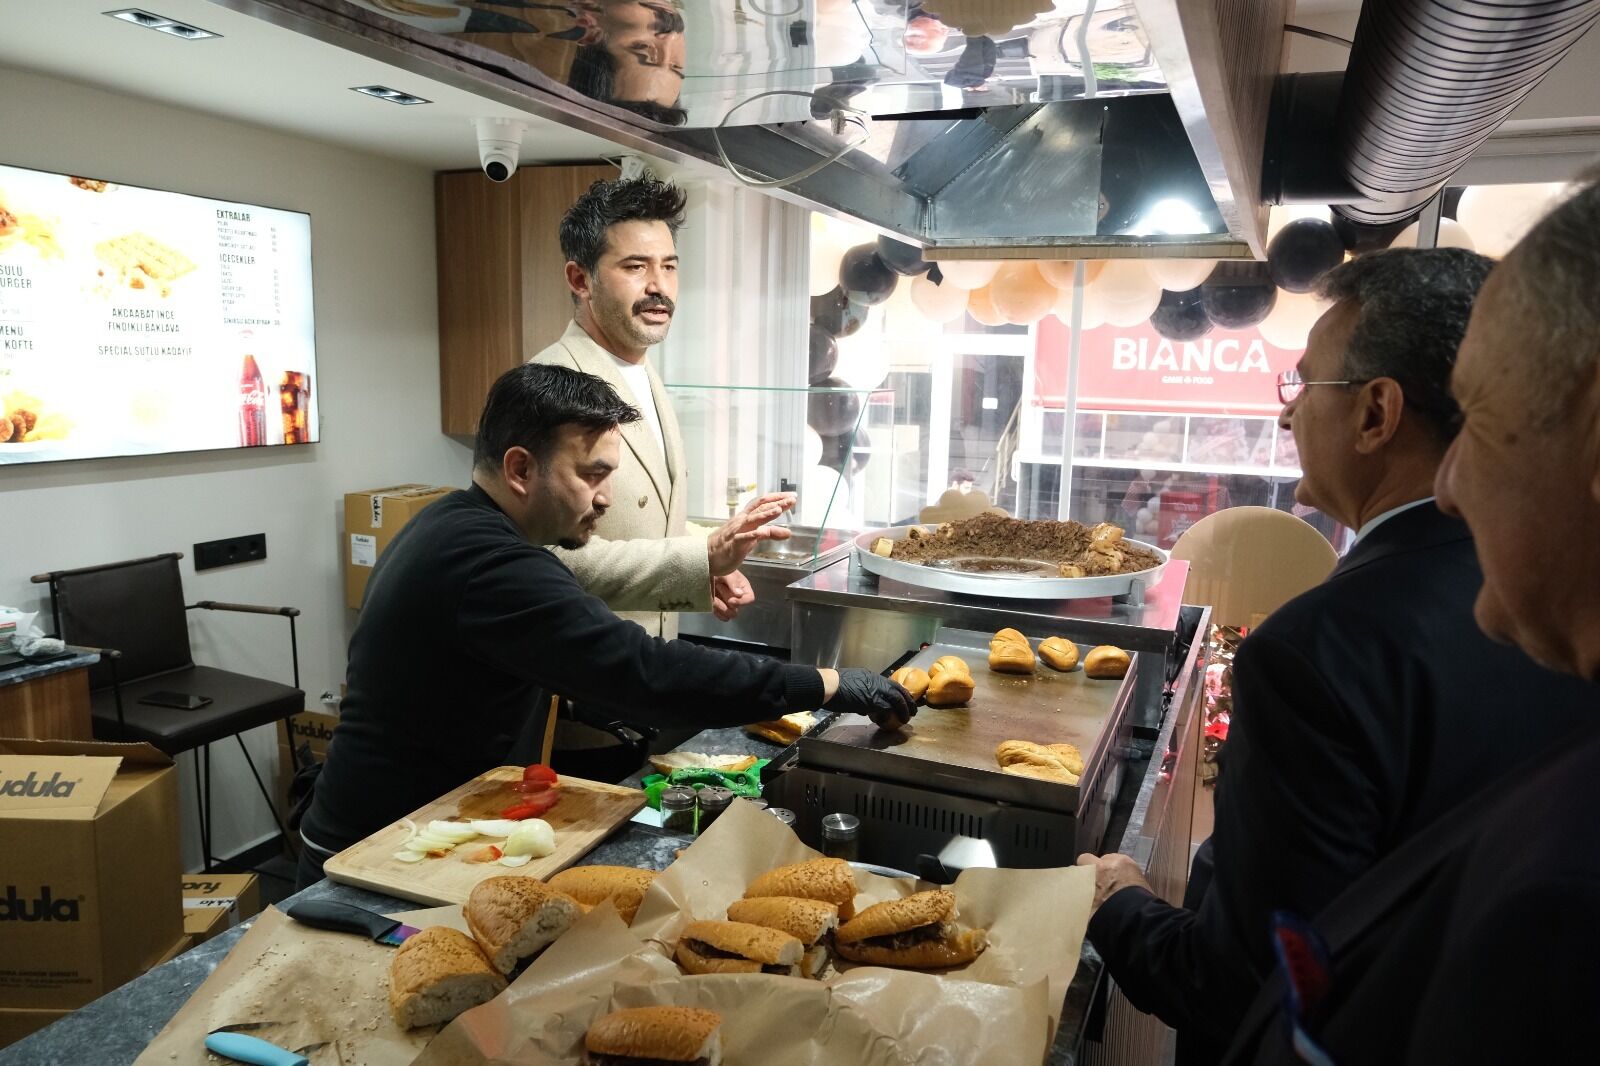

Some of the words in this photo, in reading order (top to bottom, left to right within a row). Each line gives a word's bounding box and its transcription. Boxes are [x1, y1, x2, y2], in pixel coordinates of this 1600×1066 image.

[216, 209, 250, 222] EXTRALAR
[112, 308, 154, 318] AKCAABAT
[109, 321, 143, 331] FINDIKLI
[146, 323, 179, 332] BAKLAVA
[99, 345, 132, 355] SPECIAL
[134, 346, 159, 355] SUTLU
[1112, 337, 1271, 373] BIANCA
[0, 770, 76, 798] udula
